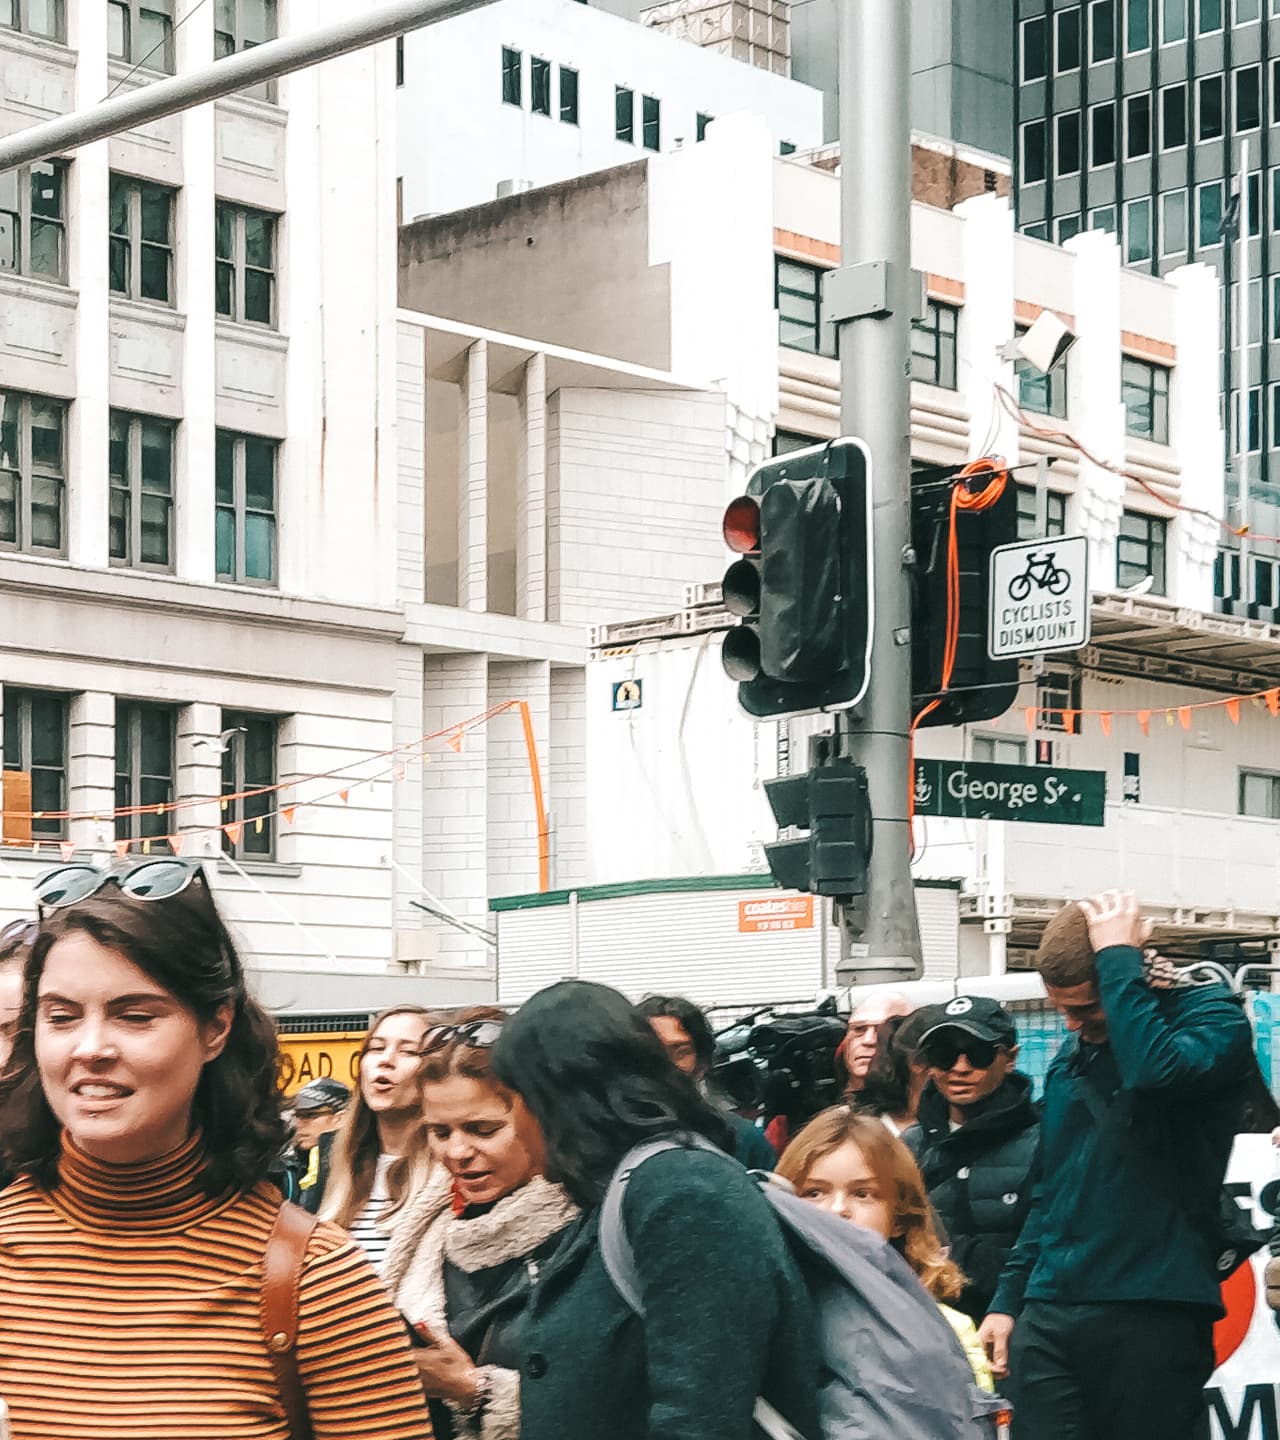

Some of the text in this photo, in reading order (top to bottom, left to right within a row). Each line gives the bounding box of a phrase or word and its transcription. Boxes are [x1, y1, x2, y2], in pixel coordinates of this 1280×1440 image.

[1002, 599, 1072, 625] CYCLISTS
[1000, 620, 1076, 647] DISMOUNT
[947, 770, 1038, 808] George
[278, 1051, 333, 1083] OAD
